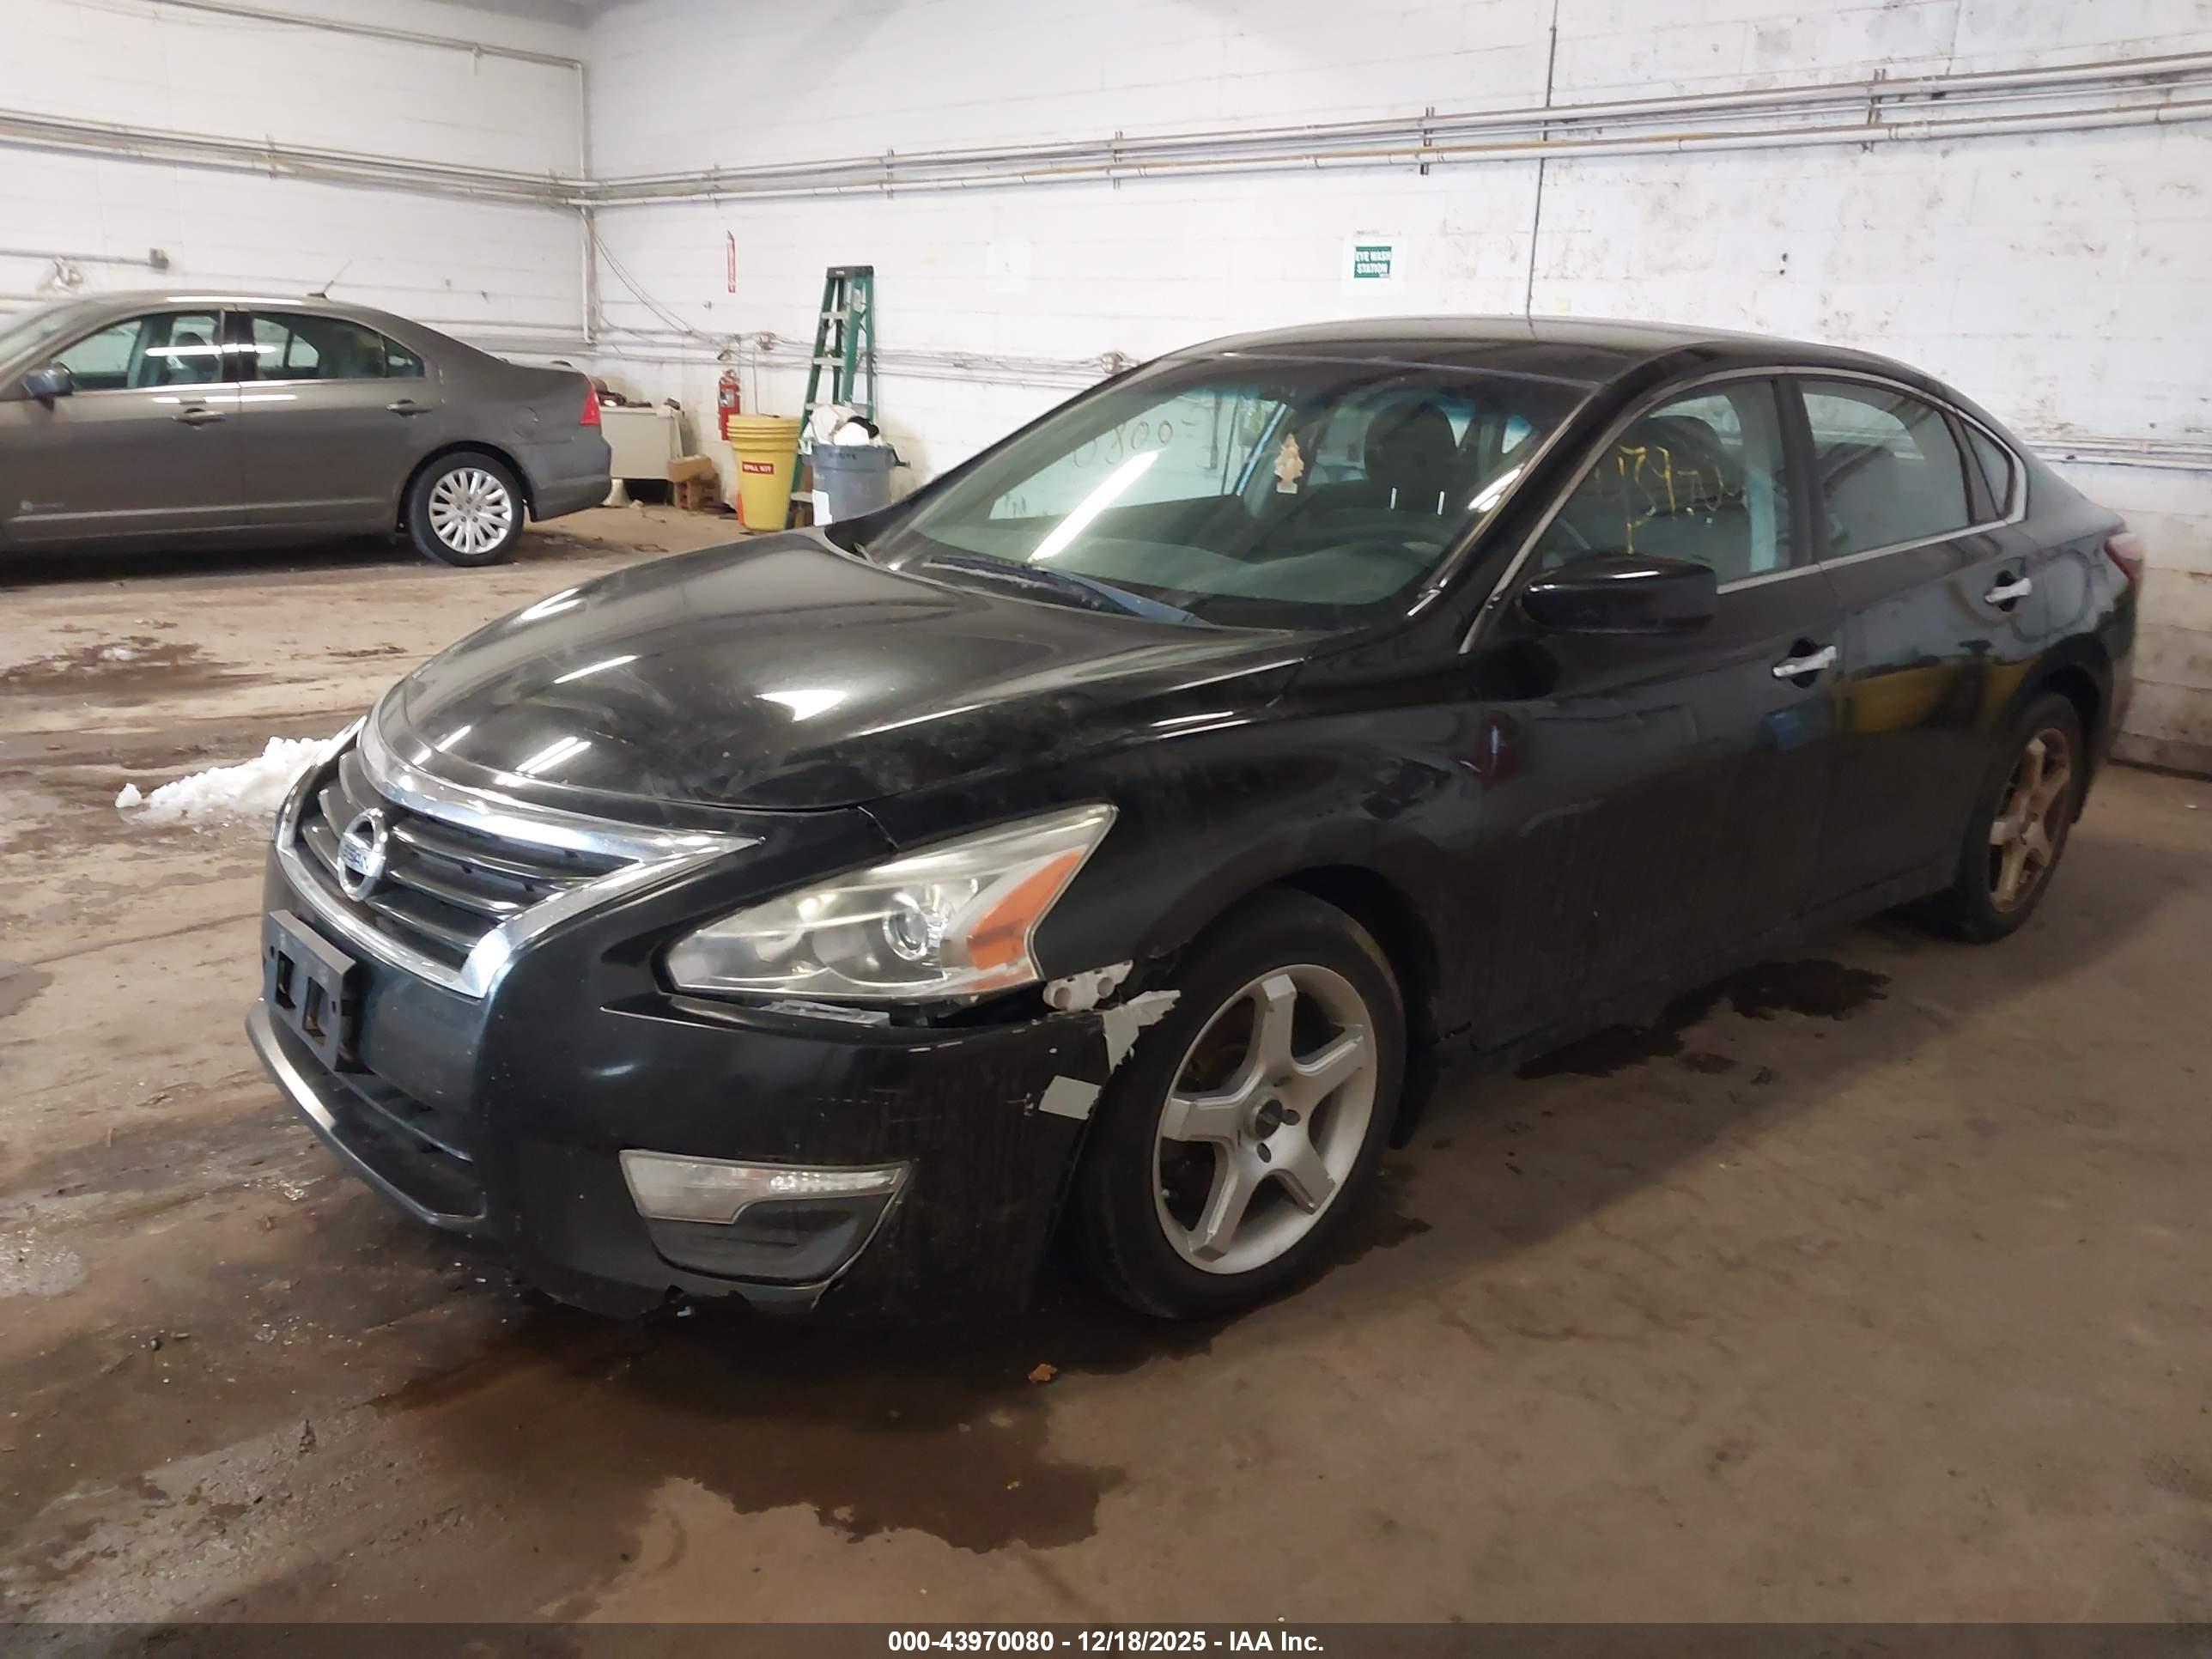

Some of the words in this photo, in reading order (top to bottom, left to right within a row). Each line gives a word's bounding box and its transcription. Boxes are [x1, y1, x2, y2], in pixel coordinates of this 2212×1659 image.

[1355, 251, 1370, 262] EYE
[1370, 251, 1392, 261] WASH
[1356, 263, 1389, 274] STATION
[743, 464, 758, 472] SPILL
